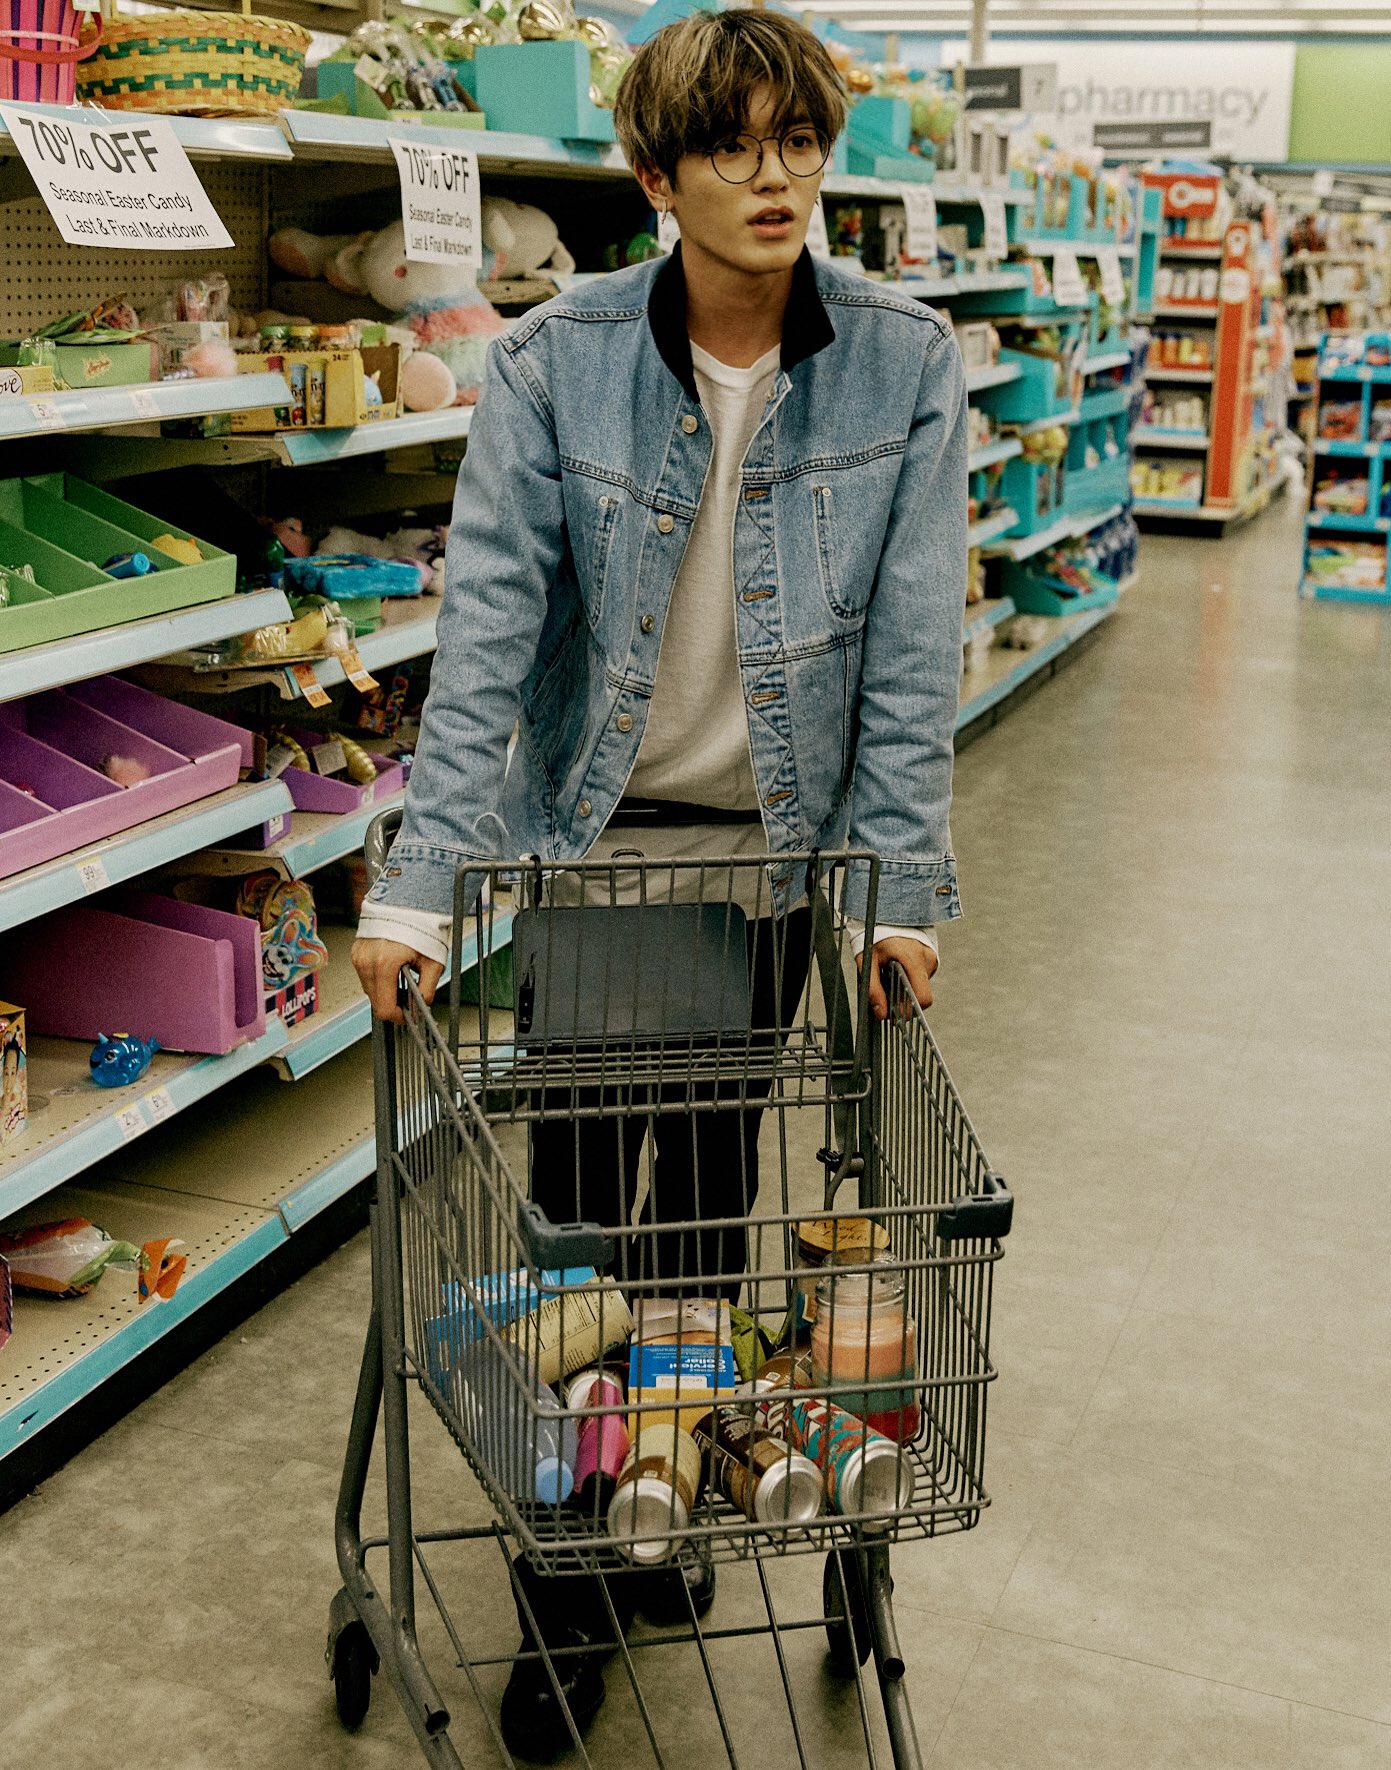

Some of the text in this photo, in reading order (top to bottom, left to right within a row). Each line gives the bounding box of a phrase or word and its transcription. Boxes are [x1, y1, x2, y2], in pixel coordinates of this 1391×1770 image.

[1056, 78, 1269, 126] pharmacy
[18, 117, 159, 174] 70% OFF
[401, 146, 470, 193] 70% OFF
[49, 182, 194, 212] Seasonal Easter Candy
[66, 214, 210, 240] Last & Final Markdown
[281, 986, 317, 1018] LOLLIPOPS
